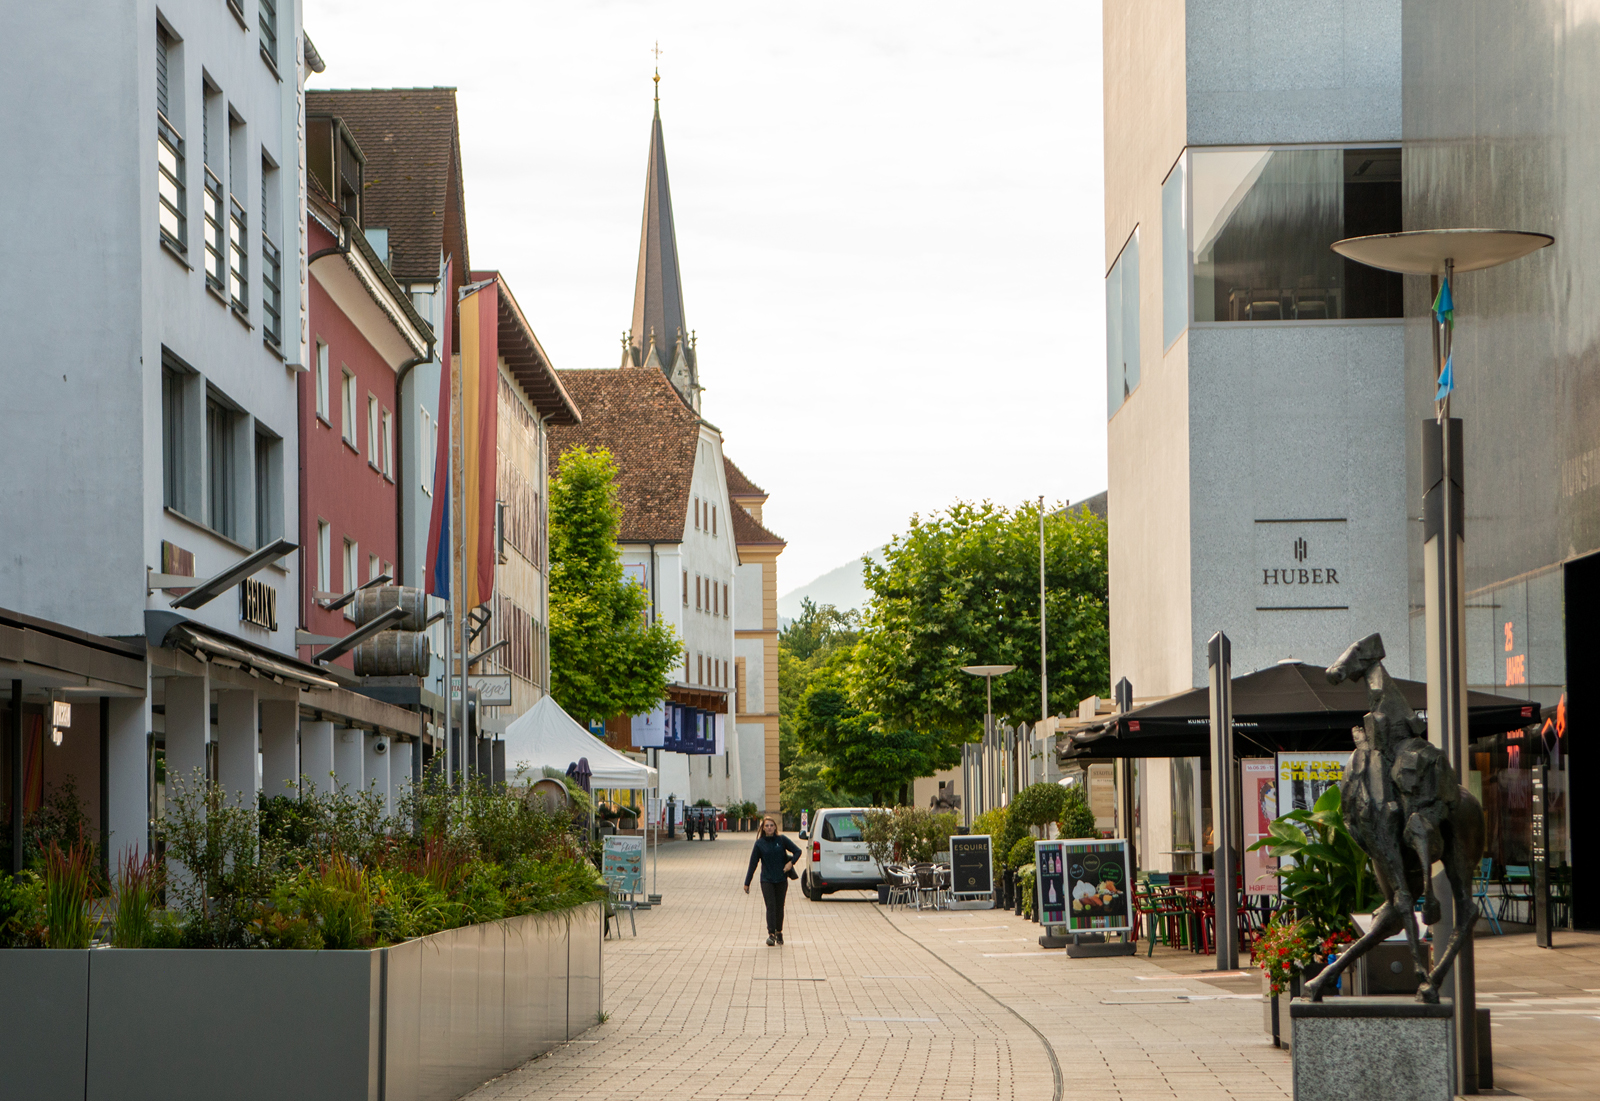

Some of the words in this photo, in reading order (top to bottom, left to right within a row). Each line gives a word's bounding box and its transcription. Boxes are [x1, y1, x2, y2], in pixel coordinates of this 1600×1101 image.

[1262, 568, 1340, 585] HUBER
[243, 577, 270, 629] FELIX
[1504, 621, 1513, 652] 25
[1505, 654, 1525, 687] JAHRE
[1280, 760, 1309, 770] AUF
[1311, 760, 1341, 770] DER
[1280, 770, 1344, 781] STRASSE
[954, 843, 988, 851] ESQUIRE
